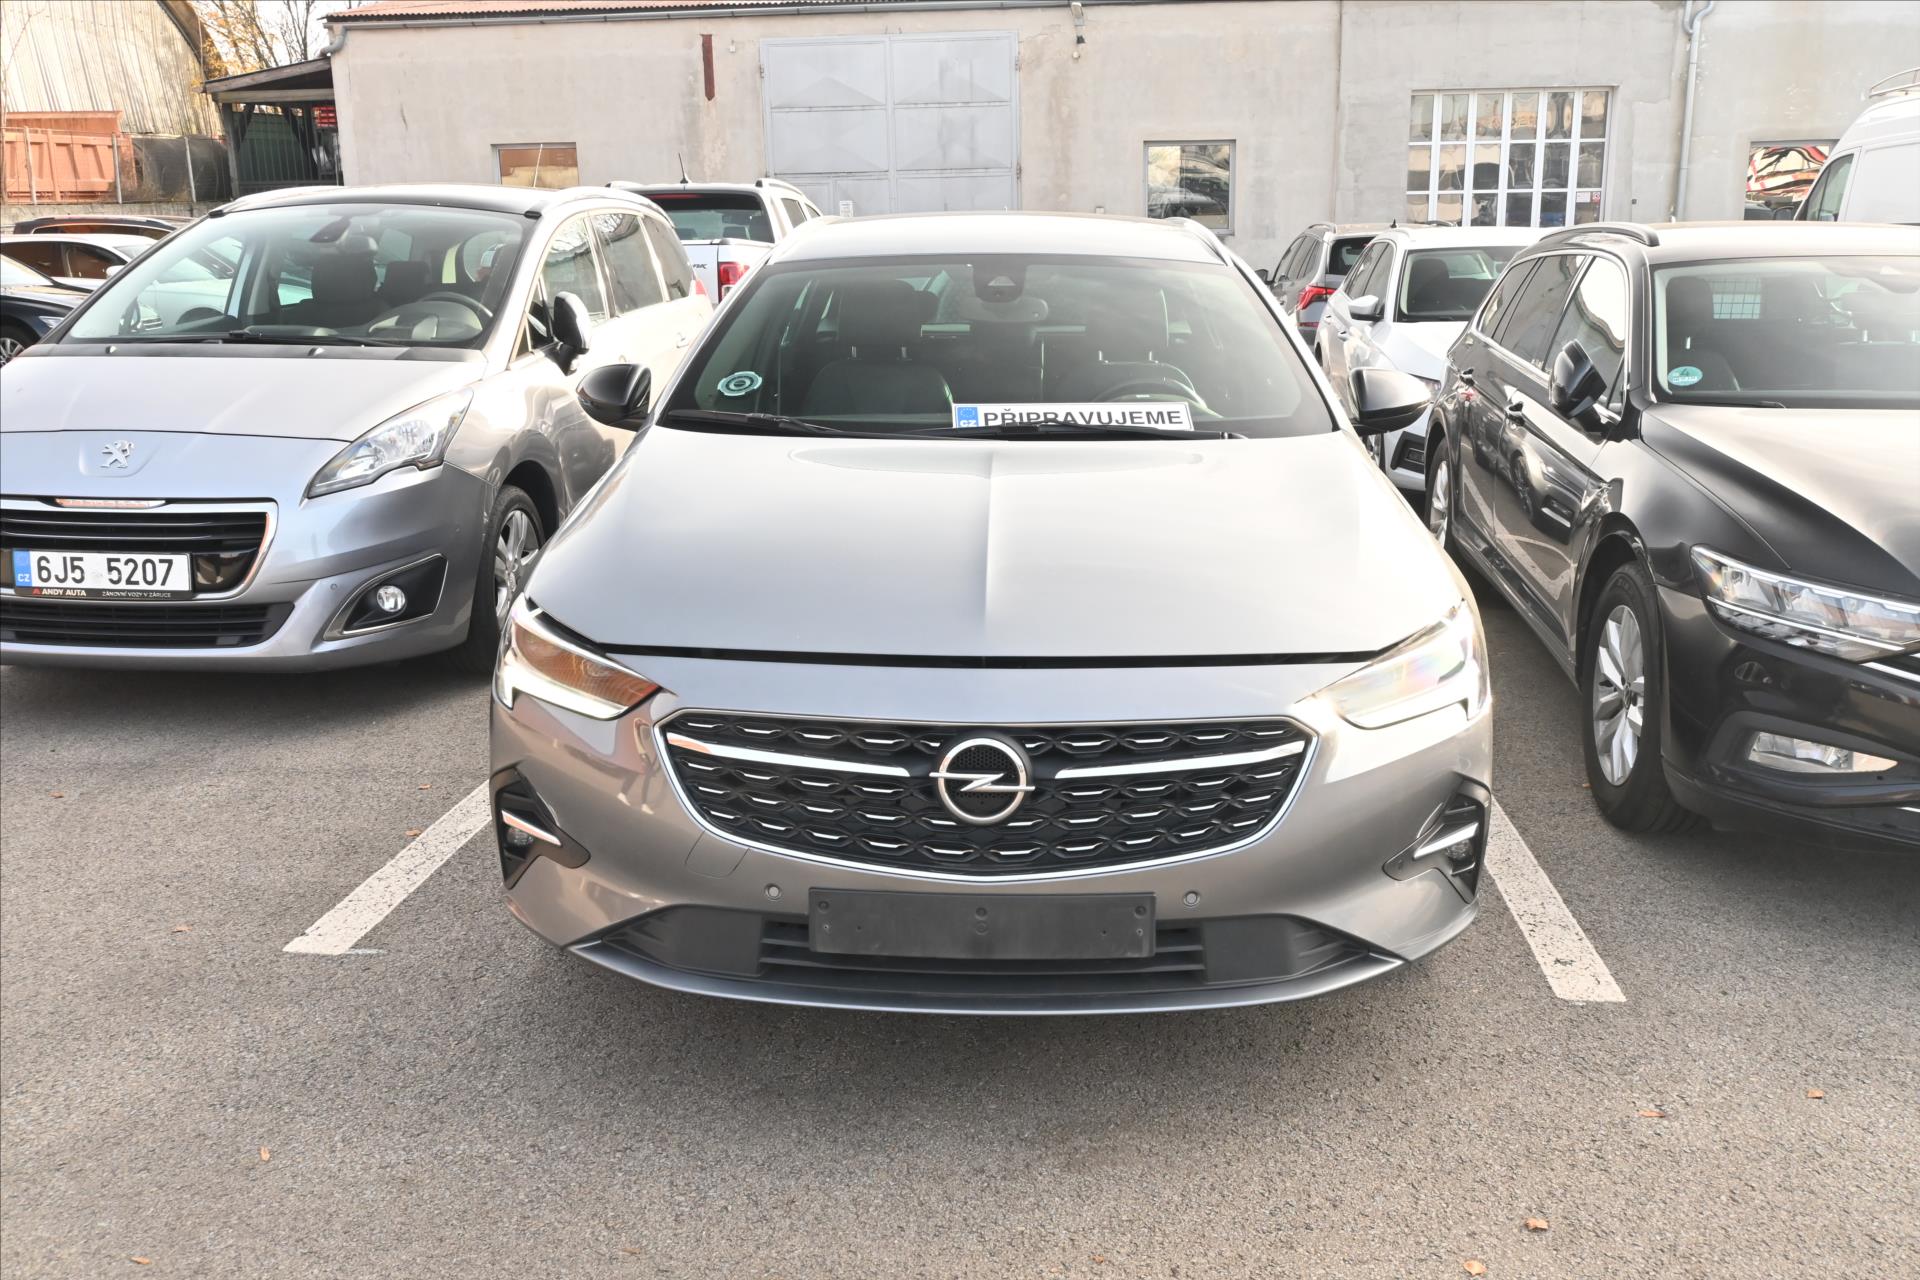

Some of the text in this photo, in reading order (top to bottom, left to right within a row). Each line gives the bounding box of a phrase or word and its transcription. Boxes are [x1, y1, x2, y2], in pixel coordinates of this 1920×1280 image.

[983, 408, 1183, 426] PŘIPRAVUJEME
[37, 555, 174, 586] 6J5 5207
[18, 574, 30, 582] CZ
[42, 588, 87, 597] ANDY AUTA
